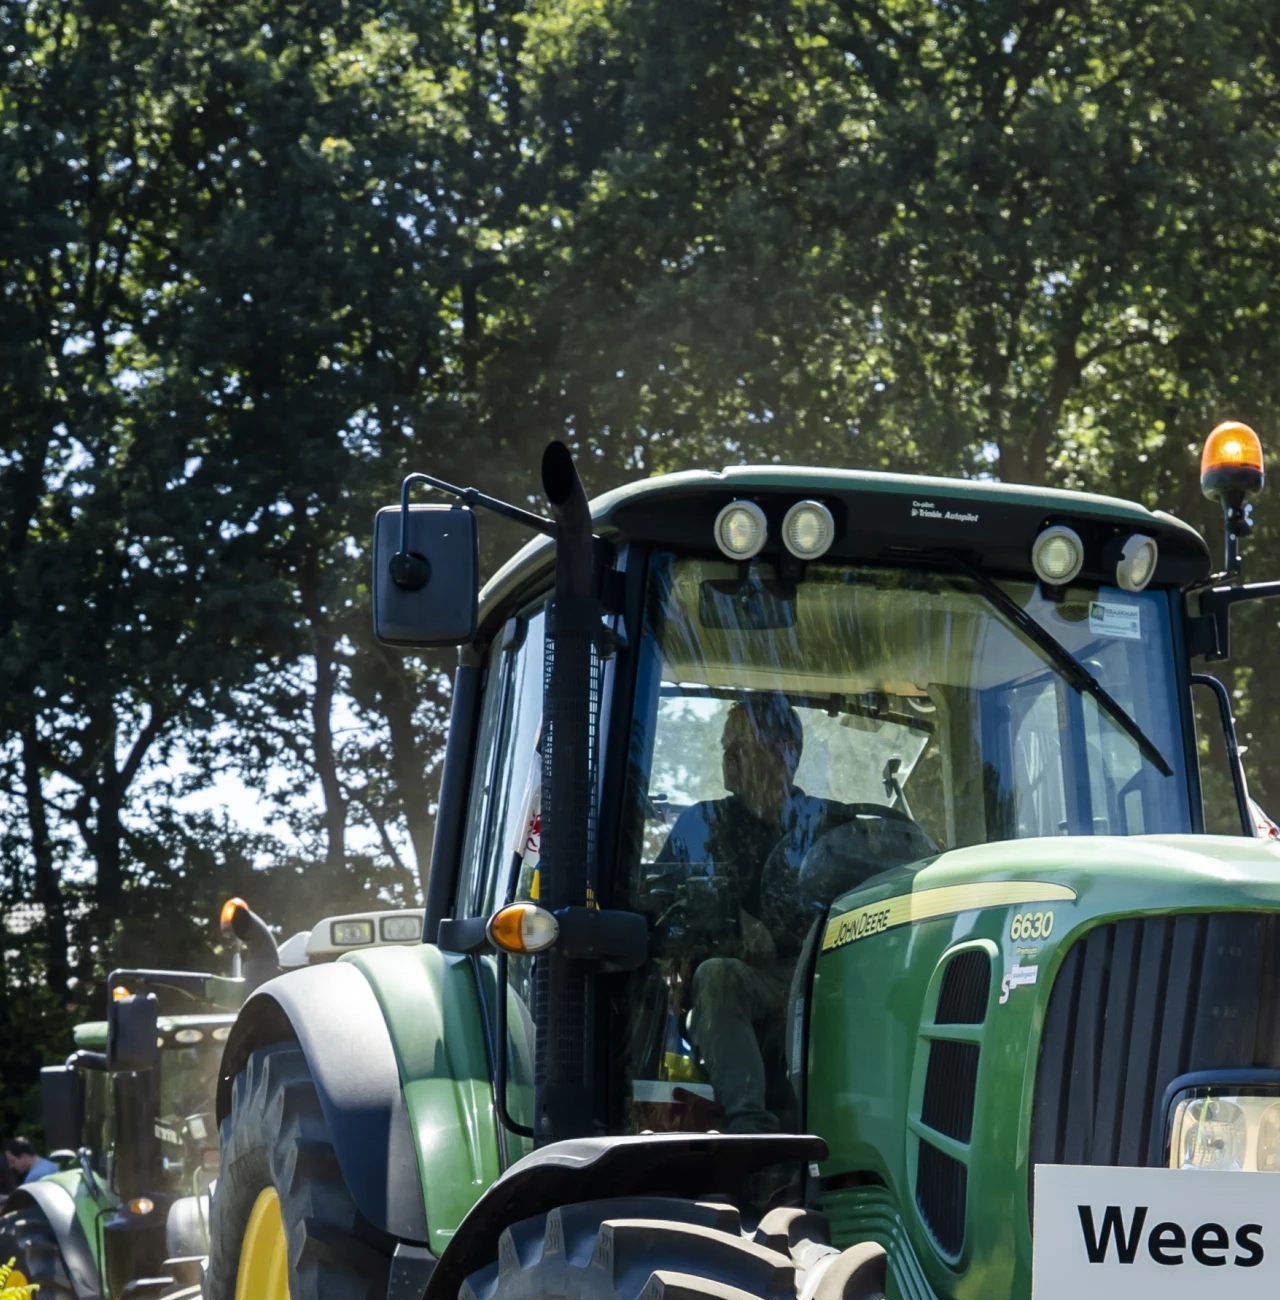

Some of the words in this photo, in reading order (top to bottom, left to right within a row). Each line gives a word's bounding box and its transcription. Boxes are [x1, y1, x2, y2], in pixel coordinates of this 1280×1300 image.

[944, 511, 979, 522] Autopilot
[833, 919, 861, 945] JOHN
[858, 911, 891, 935] DEERE
[1010, 910, 1054, 942] 6630
[1078, 1206, 1263, 1267] Wees
